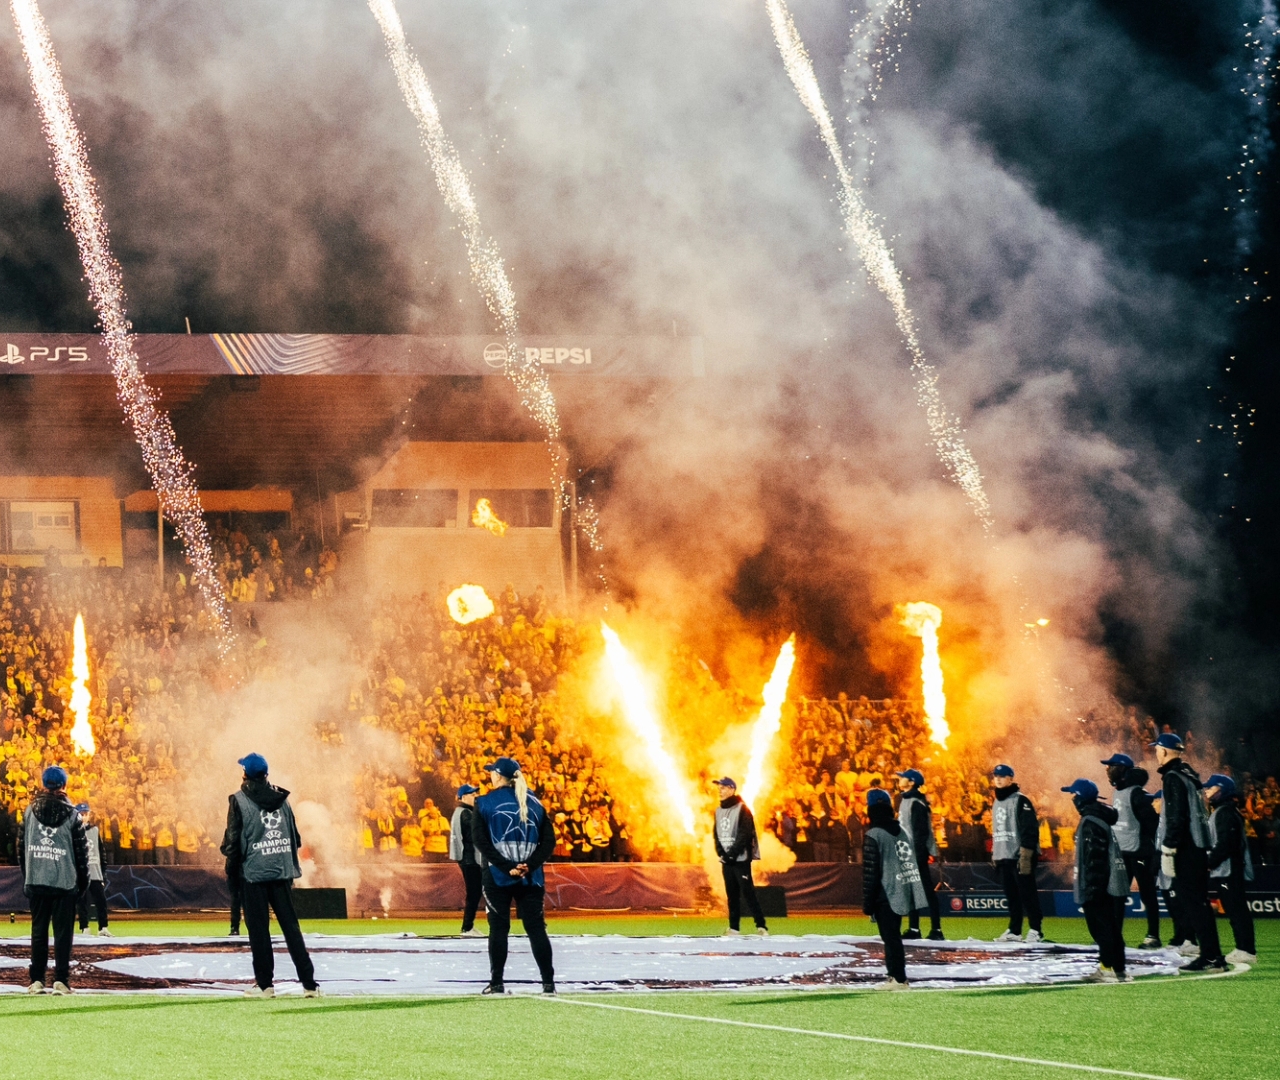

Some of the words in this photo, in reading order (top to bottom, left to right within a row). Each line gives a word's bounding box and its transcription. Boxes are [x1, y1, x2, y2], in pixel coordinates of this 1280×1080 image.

[29, 346, 89, 361] PS5
[524, 347, 592, 364] PEPSI
[966, 898, 1009, 909] RESPEC
